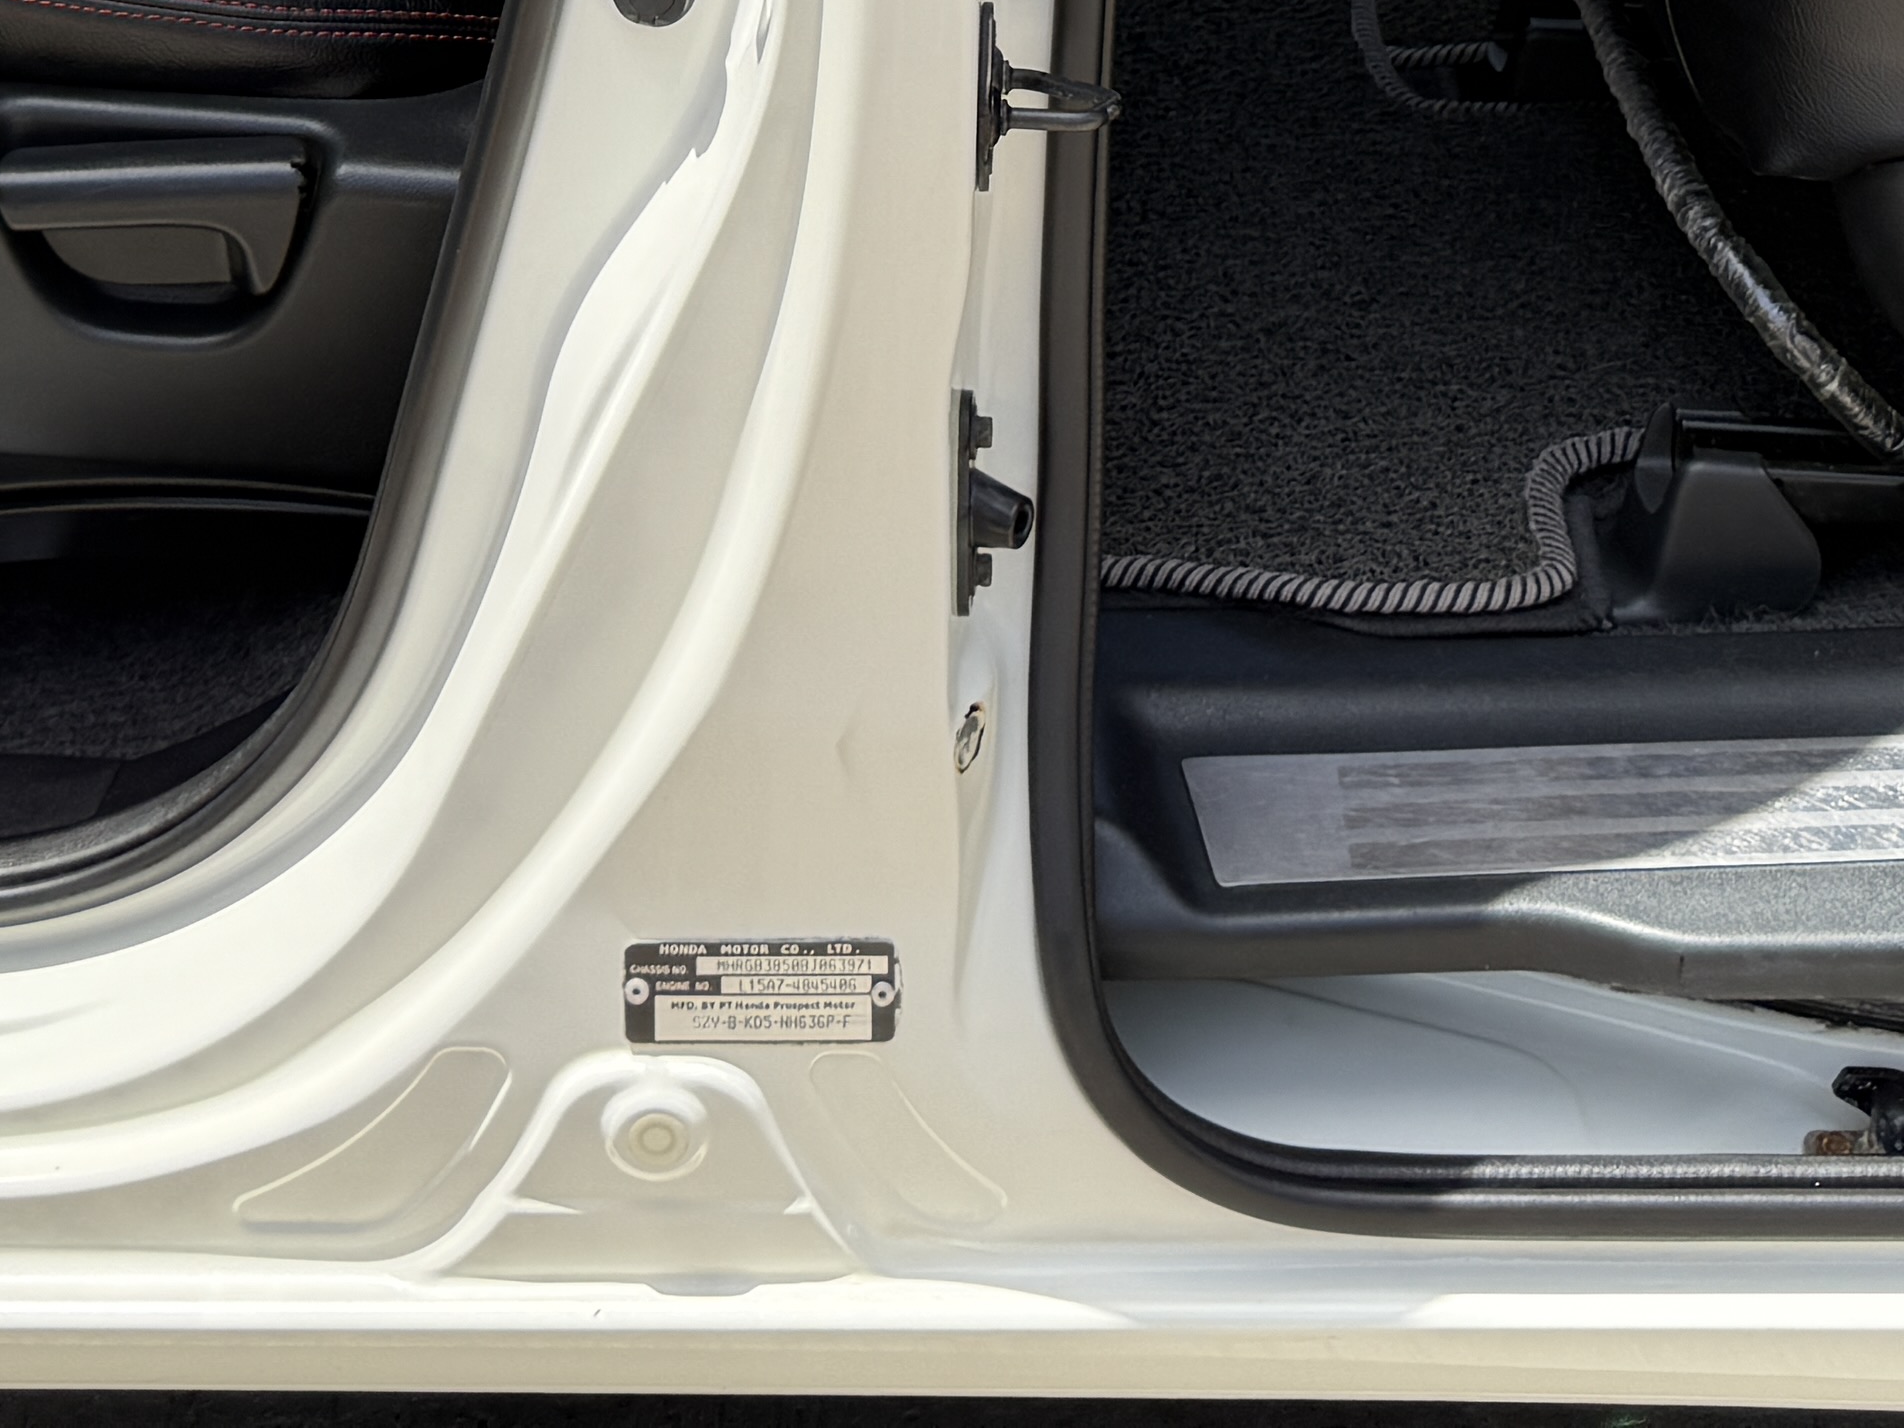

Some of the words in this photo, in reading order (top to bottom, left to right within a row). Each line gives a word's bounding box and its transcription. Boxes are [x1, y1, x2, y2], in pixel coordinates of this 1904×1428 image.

[659, 944, 707, 956] HONDA
[720, 944, 769, 956] MOTOR
[780, 944, 815, 956] CO.,
[827, 944, 860, 956] LTD.
[701, 1001, 715, 1010] BY
[719, 1001, 732, 1010] PT
[735, 1001, 770, 1010] Honda
[773, 1001, 820, 1012] Prospect
[823, 1001, 856, 1010] Motor
